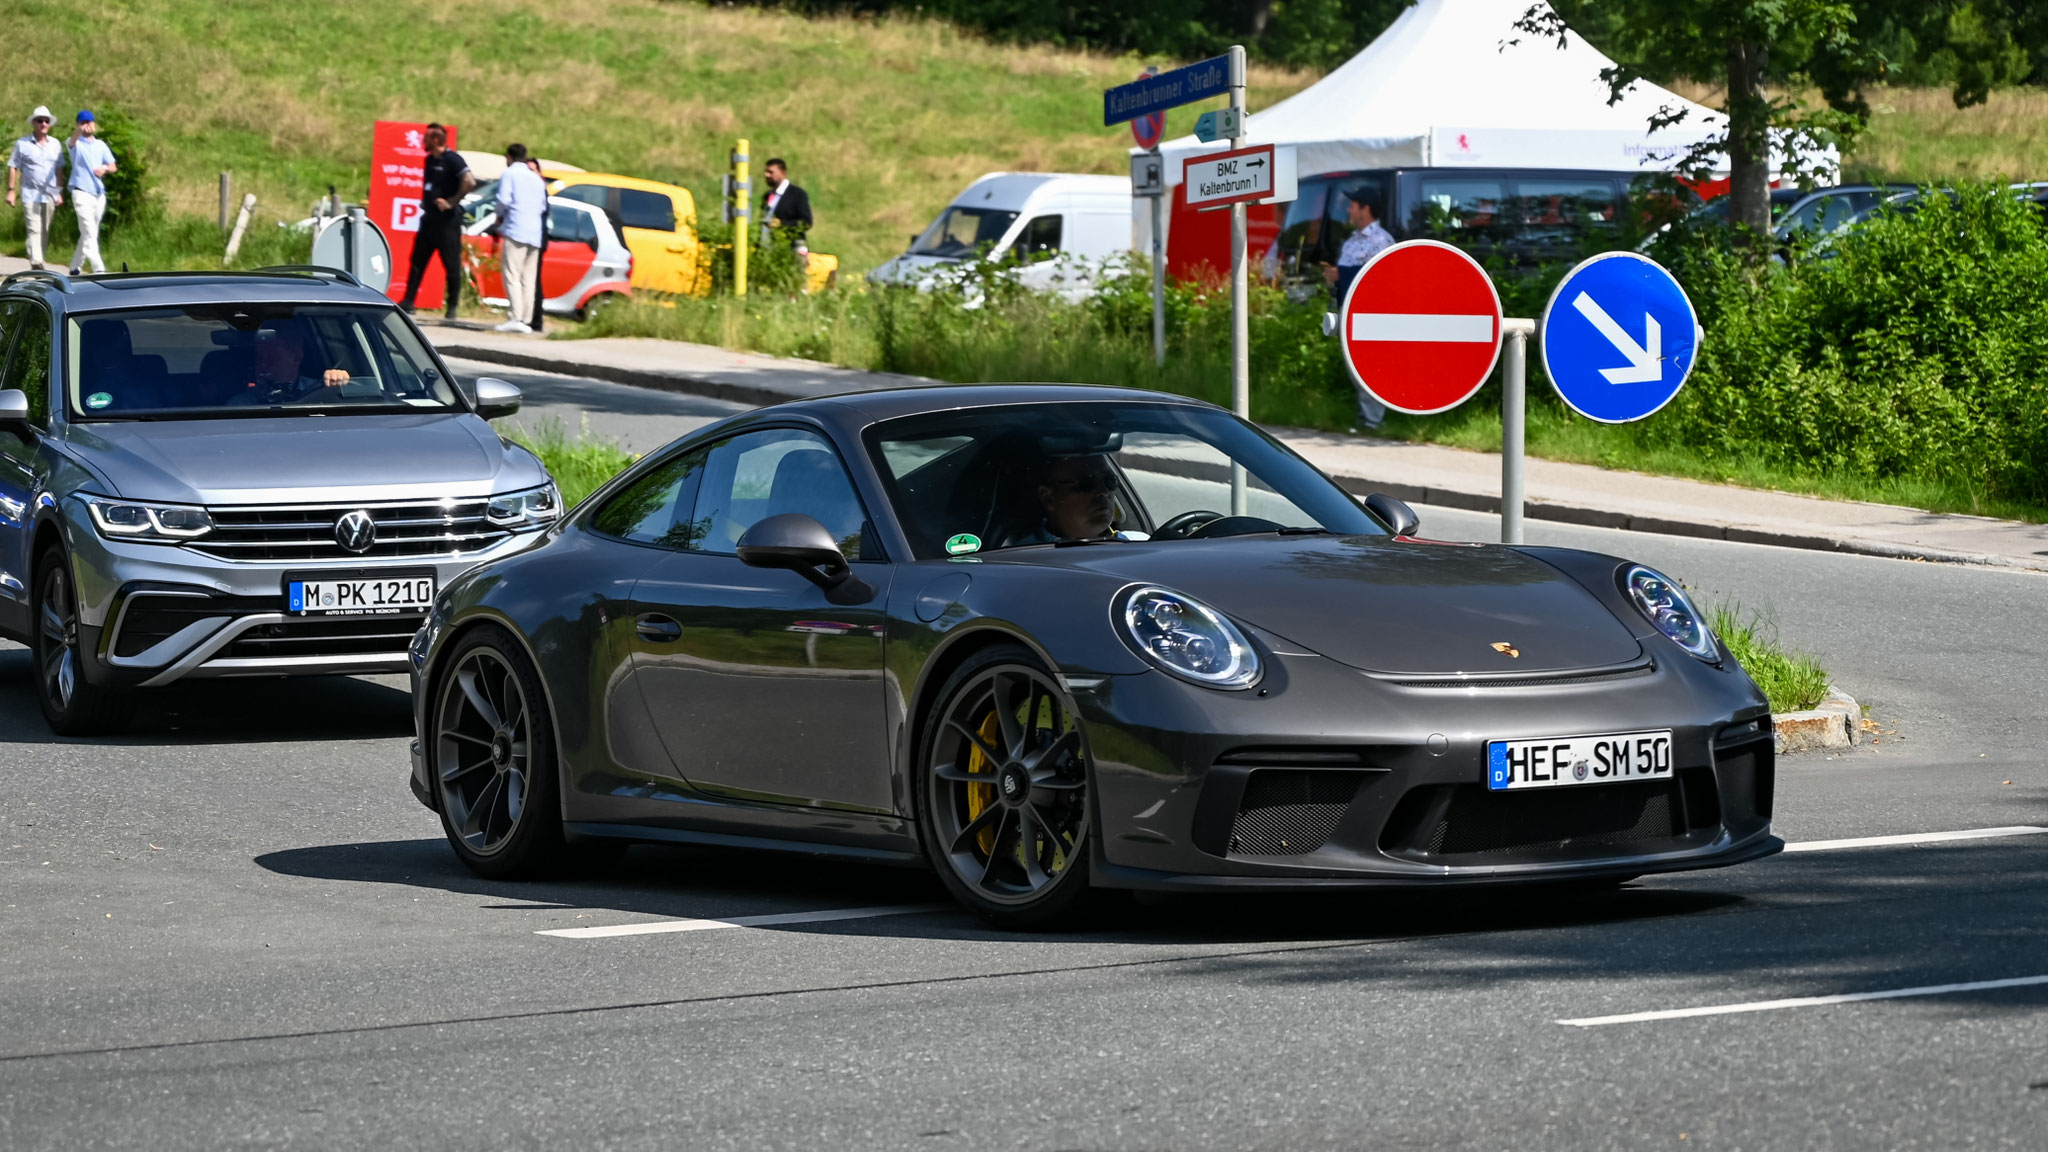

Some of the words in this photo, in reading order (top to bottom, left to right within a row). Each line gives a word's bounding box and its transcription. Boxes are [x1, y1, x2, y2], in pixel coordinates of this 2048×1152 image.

[1110, 80, 1183, 115] Kaltenbrunner
[1188, 65, 1222, 93] Straße
[1624, 143, 1695, 157] Informatio
[382, 164, 399, 174] VIP
[1217, 160, 1238, 177] BMZ
[386, 176, 402, 186] VIP
[402, 177, 424, 188] Park
[1199, 178, 1252, 197] Kaltenbrunn
[1253, 173, 1258, 188] 1
[399, 203, 418, 225] P
[958, 535, 968, 545] 4
[305, 584, 320, 607] M
[337, 582, 367, 606] PK
[372, 580, 430, 605] 1210
[1494, 771, 1503, 782] D
[1507, 744, 1571, 783] HEF
[1593, 740, 1630, 778] SM
[1636, 738, 1670, 775] 50
